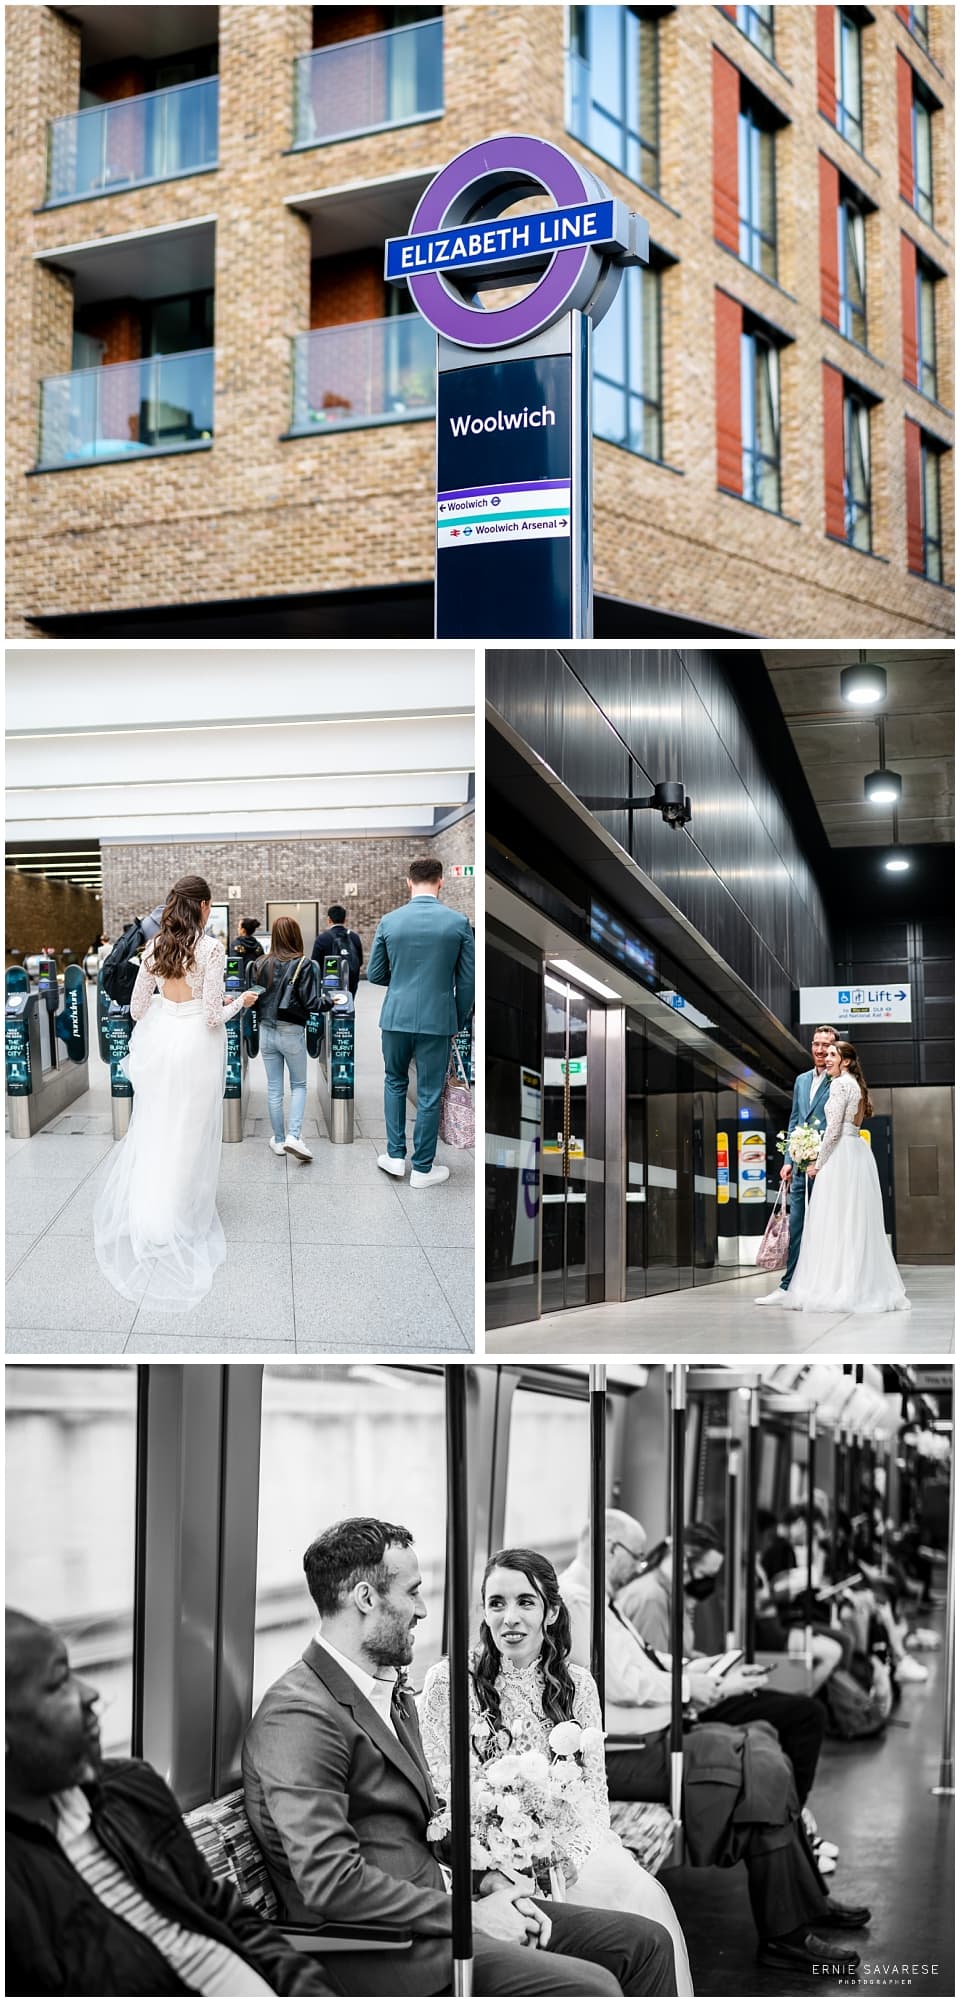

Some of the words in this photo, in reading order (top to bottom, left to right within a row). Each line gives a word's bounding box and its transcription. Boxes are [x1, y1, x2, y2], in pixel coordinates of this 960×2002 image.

[401, 225, 529, 268] ELIZABETH
[540, 213, 597, 244] LINE
[450, 405, 555, 437] Woolwich
[447, 499, 488, 511] Woolwich
[475, 522, 519, 535] Woolwich
[521, 519, 557, 530] Arsenal
[868, 990, 891, 1002] Lift
